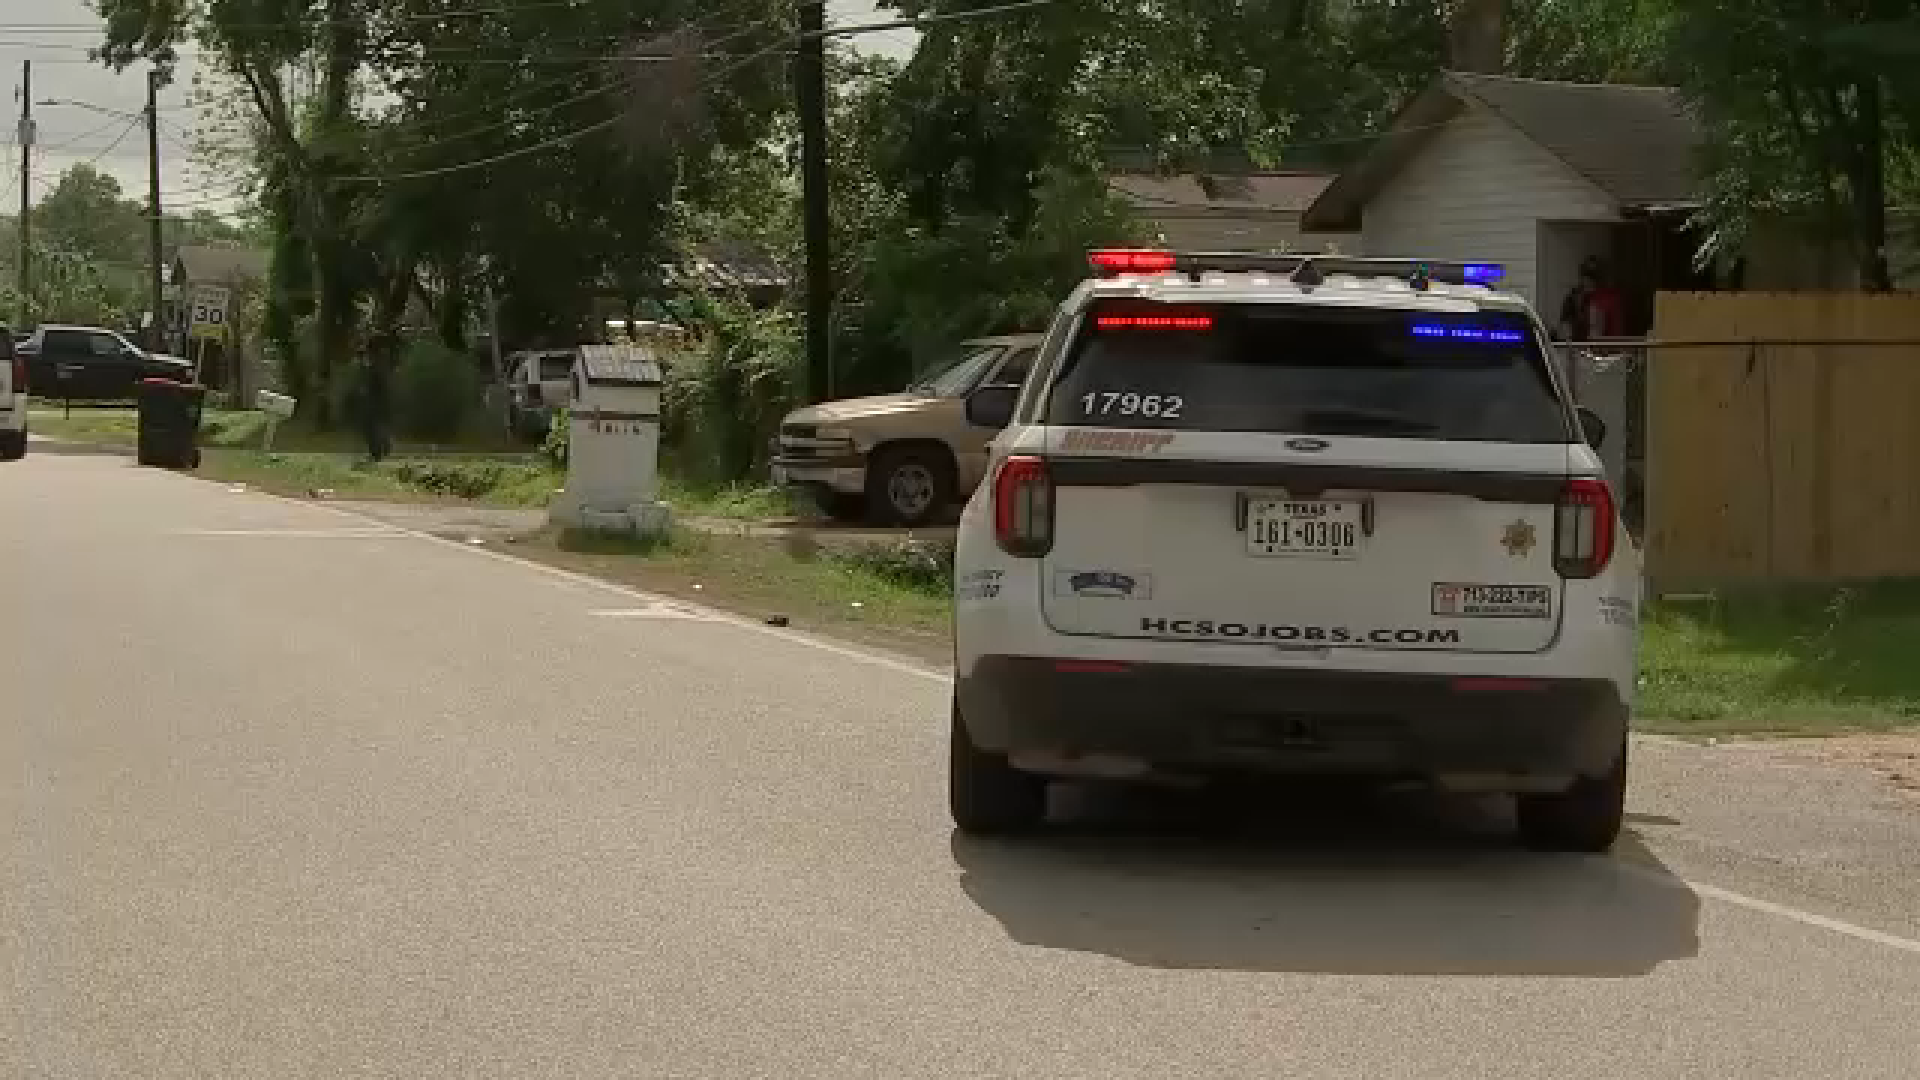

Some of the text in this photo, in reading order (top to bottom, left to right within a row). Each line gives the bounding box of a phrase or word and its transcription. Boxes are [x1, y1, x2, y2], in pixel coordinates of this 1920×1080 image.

[194, 305, 223, 325] 30
[1081, 391, 1183, 418] 17962
[1283, 503, 1327, 517] TEXAS
[1140, 617, 1461, 643] HCSOJOBS.COM
